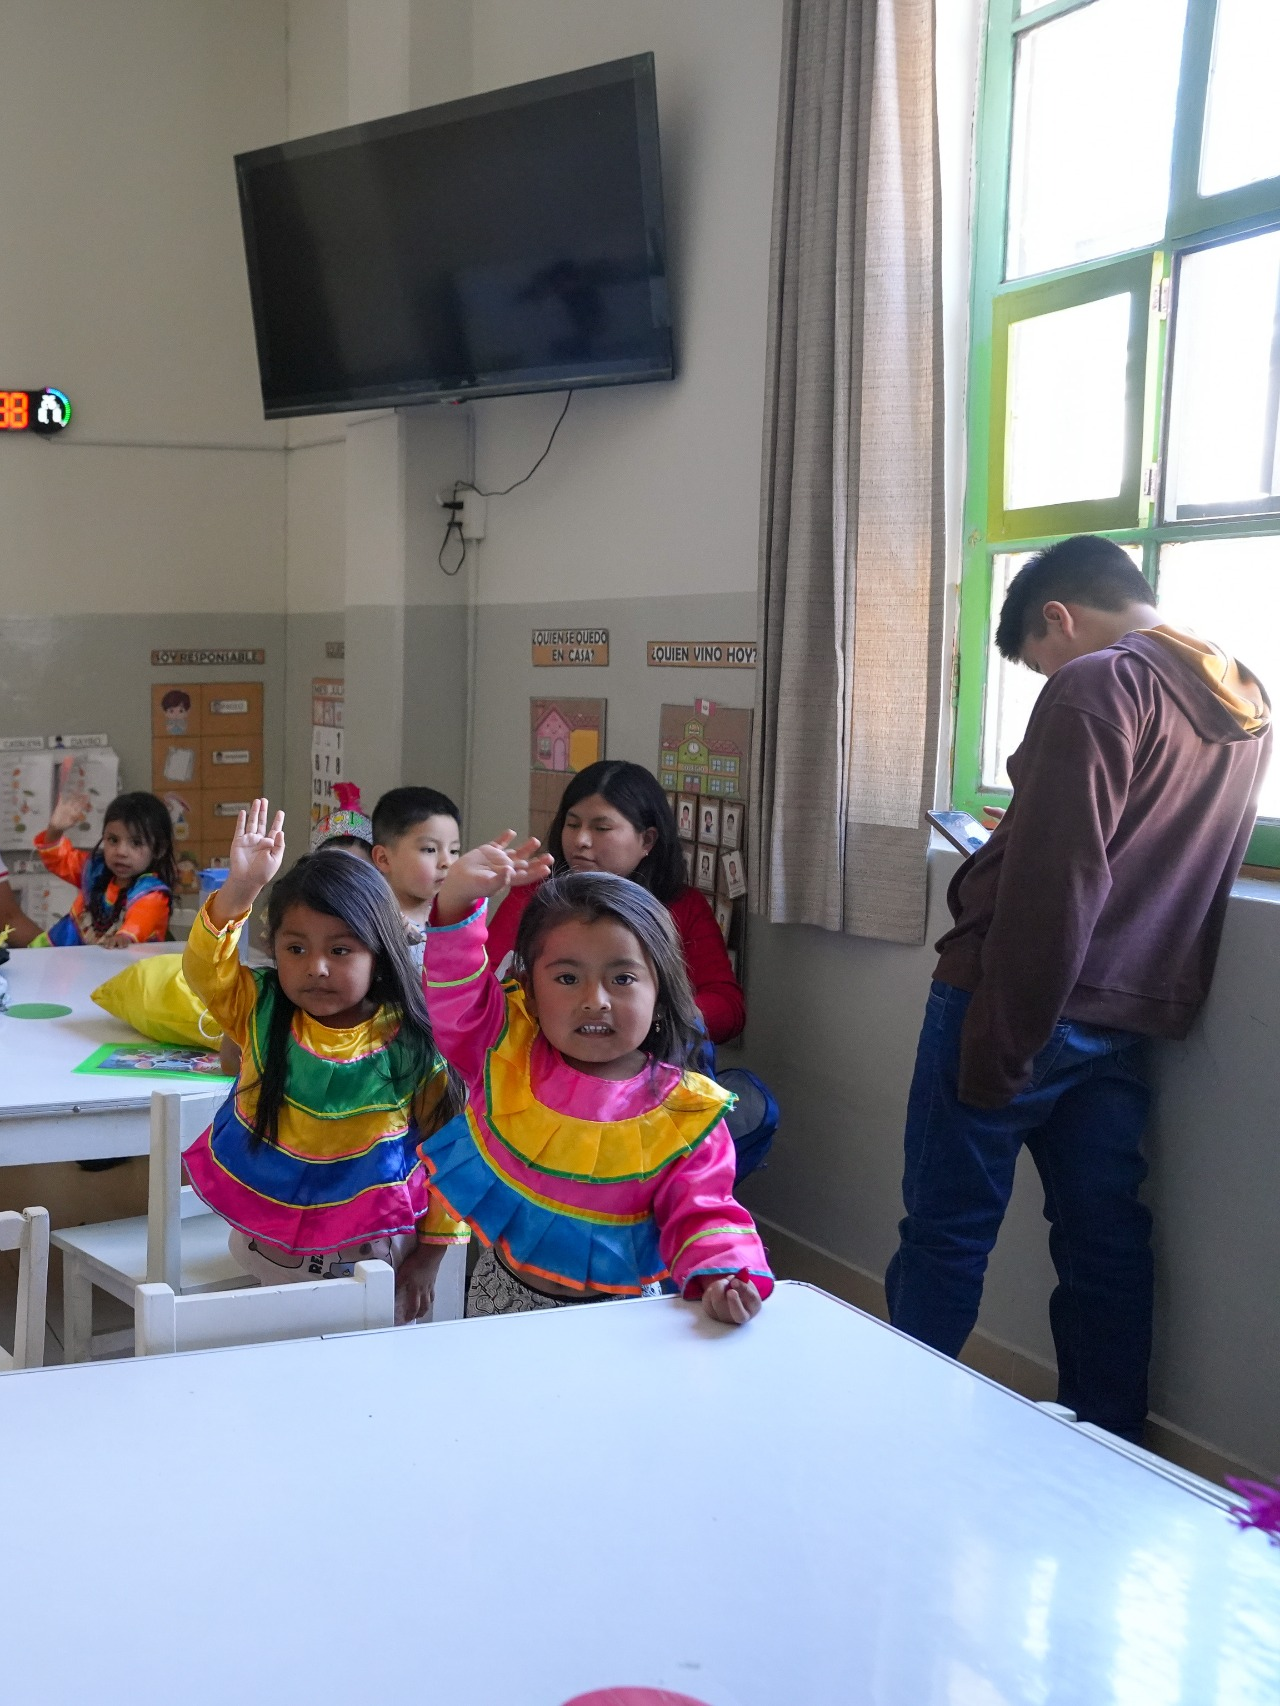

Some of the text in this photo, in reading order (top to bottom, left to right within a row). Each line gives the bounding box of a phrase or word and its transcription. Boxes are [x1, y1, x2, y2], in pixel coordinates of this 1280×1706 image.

[565, 631, 574, 644] SE
[576, 631, 608, 644] QUEDO
[155, 650, 258, 662] SOY RESPONSABLE
[552, 648, 595, 663] EN CASA?
[651, 647, 757, 663] ¿QUIEN VINO HOY?
